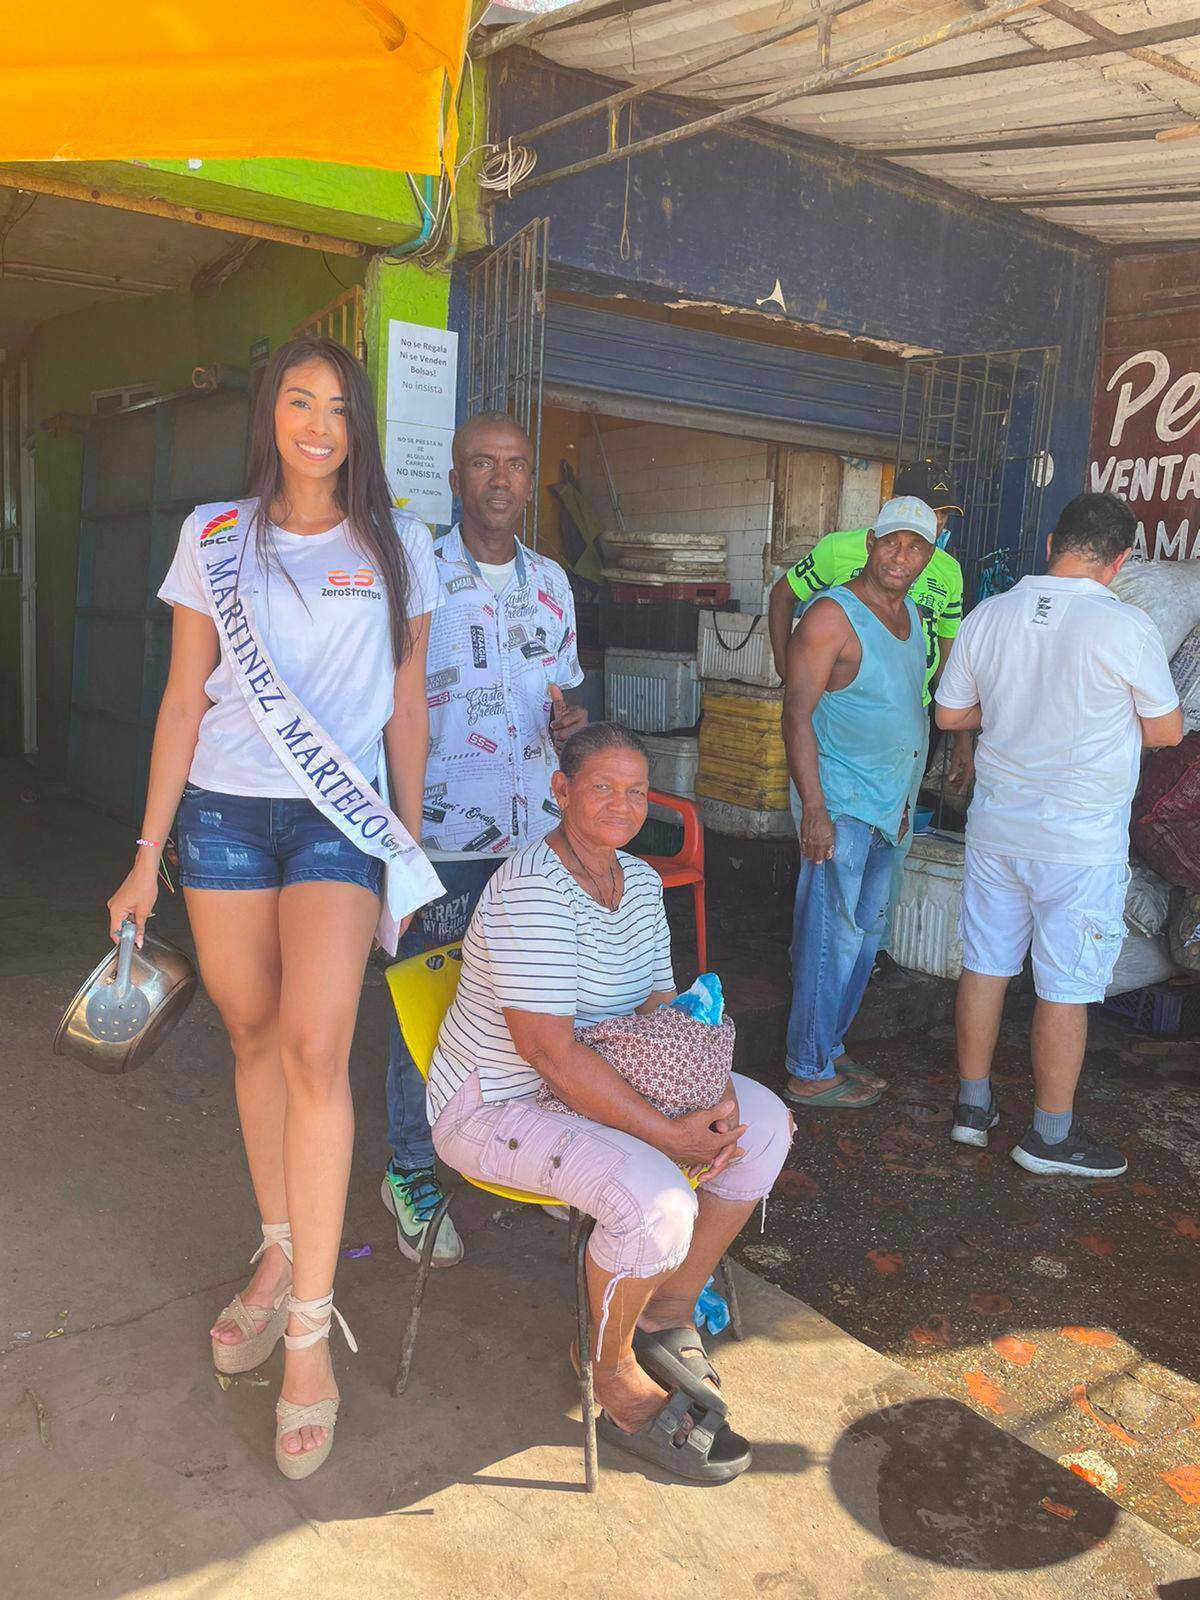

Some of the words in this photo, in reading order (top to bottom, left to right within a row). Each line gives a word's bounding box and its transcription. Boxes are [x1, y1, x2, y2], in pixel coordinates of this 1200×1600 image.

[400, 338, 412, 347] No
[413, 341, 422, 349] se
[423, 342, 448, 354] Regala
[400, 351, 408, 359] Ni
[419, 354, 448, 366] Venden
[410, 365, 437, 377] Bolsas!
[402, 380, 413, 390] No
[415, 381, 443, 394] insista
[415, 438, 437, 447] PRESTA
[405, 459, 435, 468] CARRETAS
[407, 453, 434, 461] ALQUILAN
[396, 467, 409, 476] NO
[200, 534, 239, 548] IPCC
[321, 587, 382, 600] ZeroStratos
[206, 554, 286, 713] MARTINEZ
[277, 715, 389, 839] MARTELO
